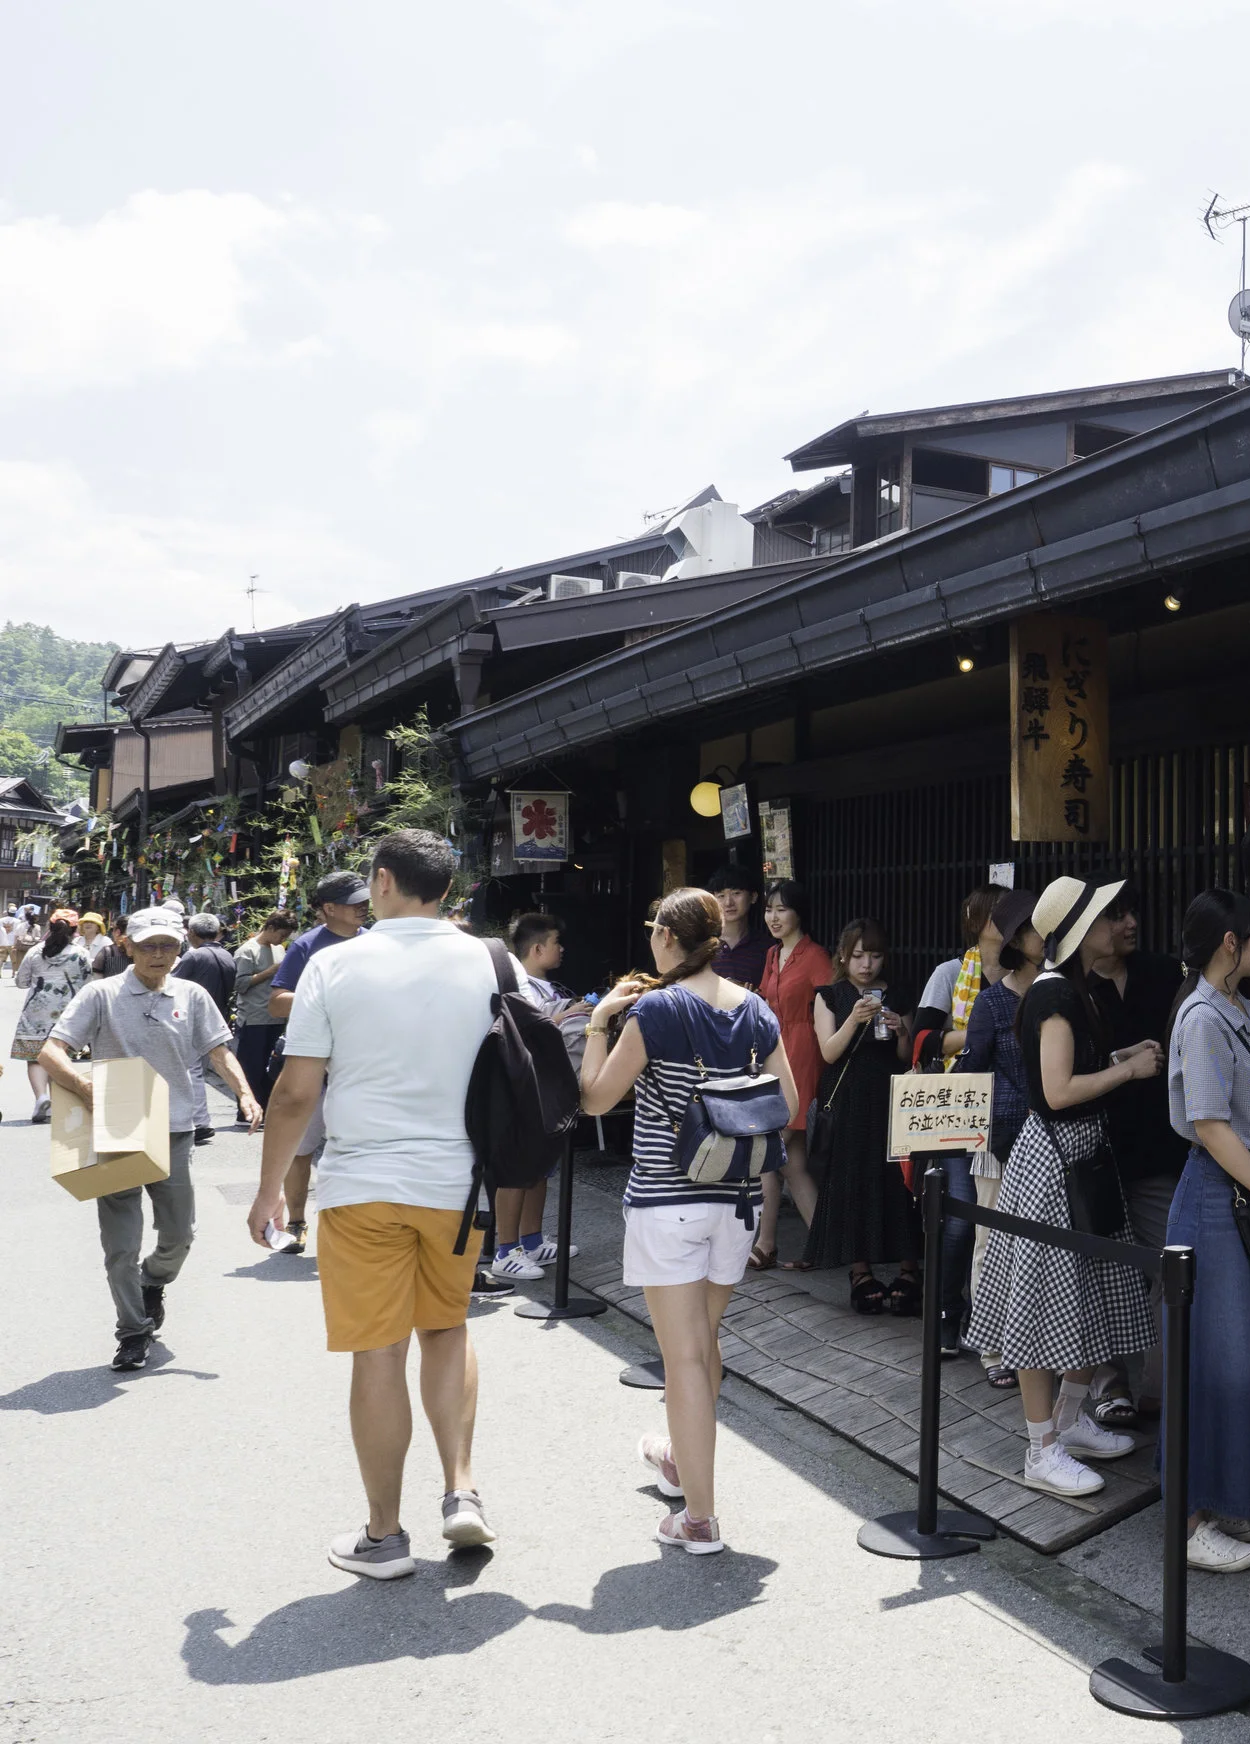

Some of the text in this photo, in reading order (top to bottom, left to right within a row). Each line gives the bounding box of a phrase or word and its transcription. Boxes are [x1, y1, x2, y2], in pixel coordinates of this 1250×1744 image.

[1022, 652, 1050, 751] 飛騨牛
[1061, 632, 1093, 835] にぎり寿司
[900, 1086, 988, 1109] お店の壁に寄って
